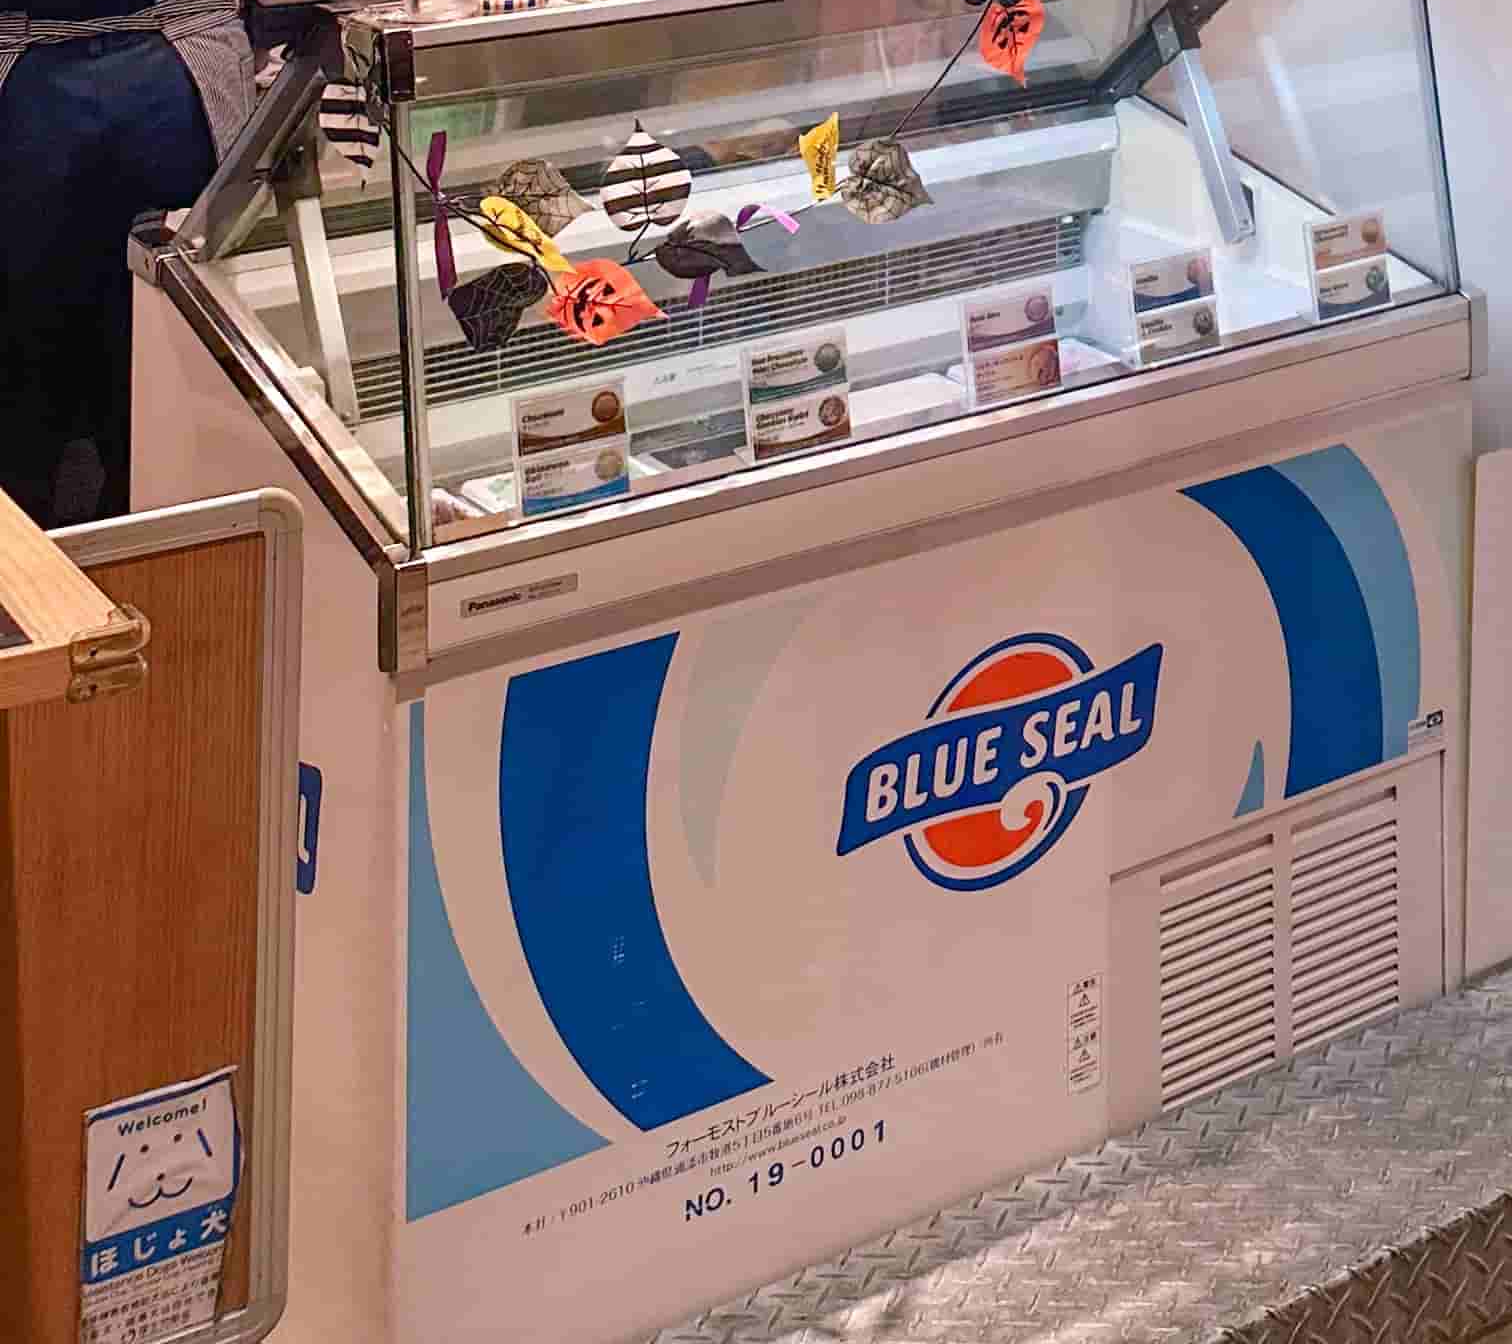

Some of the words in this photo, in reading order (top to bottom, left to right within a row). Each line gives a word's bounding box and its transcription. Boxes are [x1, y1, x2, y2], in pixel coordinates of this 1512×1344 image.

[865, 725, 1002, 824] BLUE
[1019, 681, 1143, 770] SEAL
[116, 1097, 207, 1138] Welcome!
[666, 1052, 897, 1160] フォーモストブルーシール株式会社
[683, 1187, 733, 1222] NO.
[748, 1118, 887, 1195] 19-0001
[90, 1208, 231, 1280] ほじょ犬
